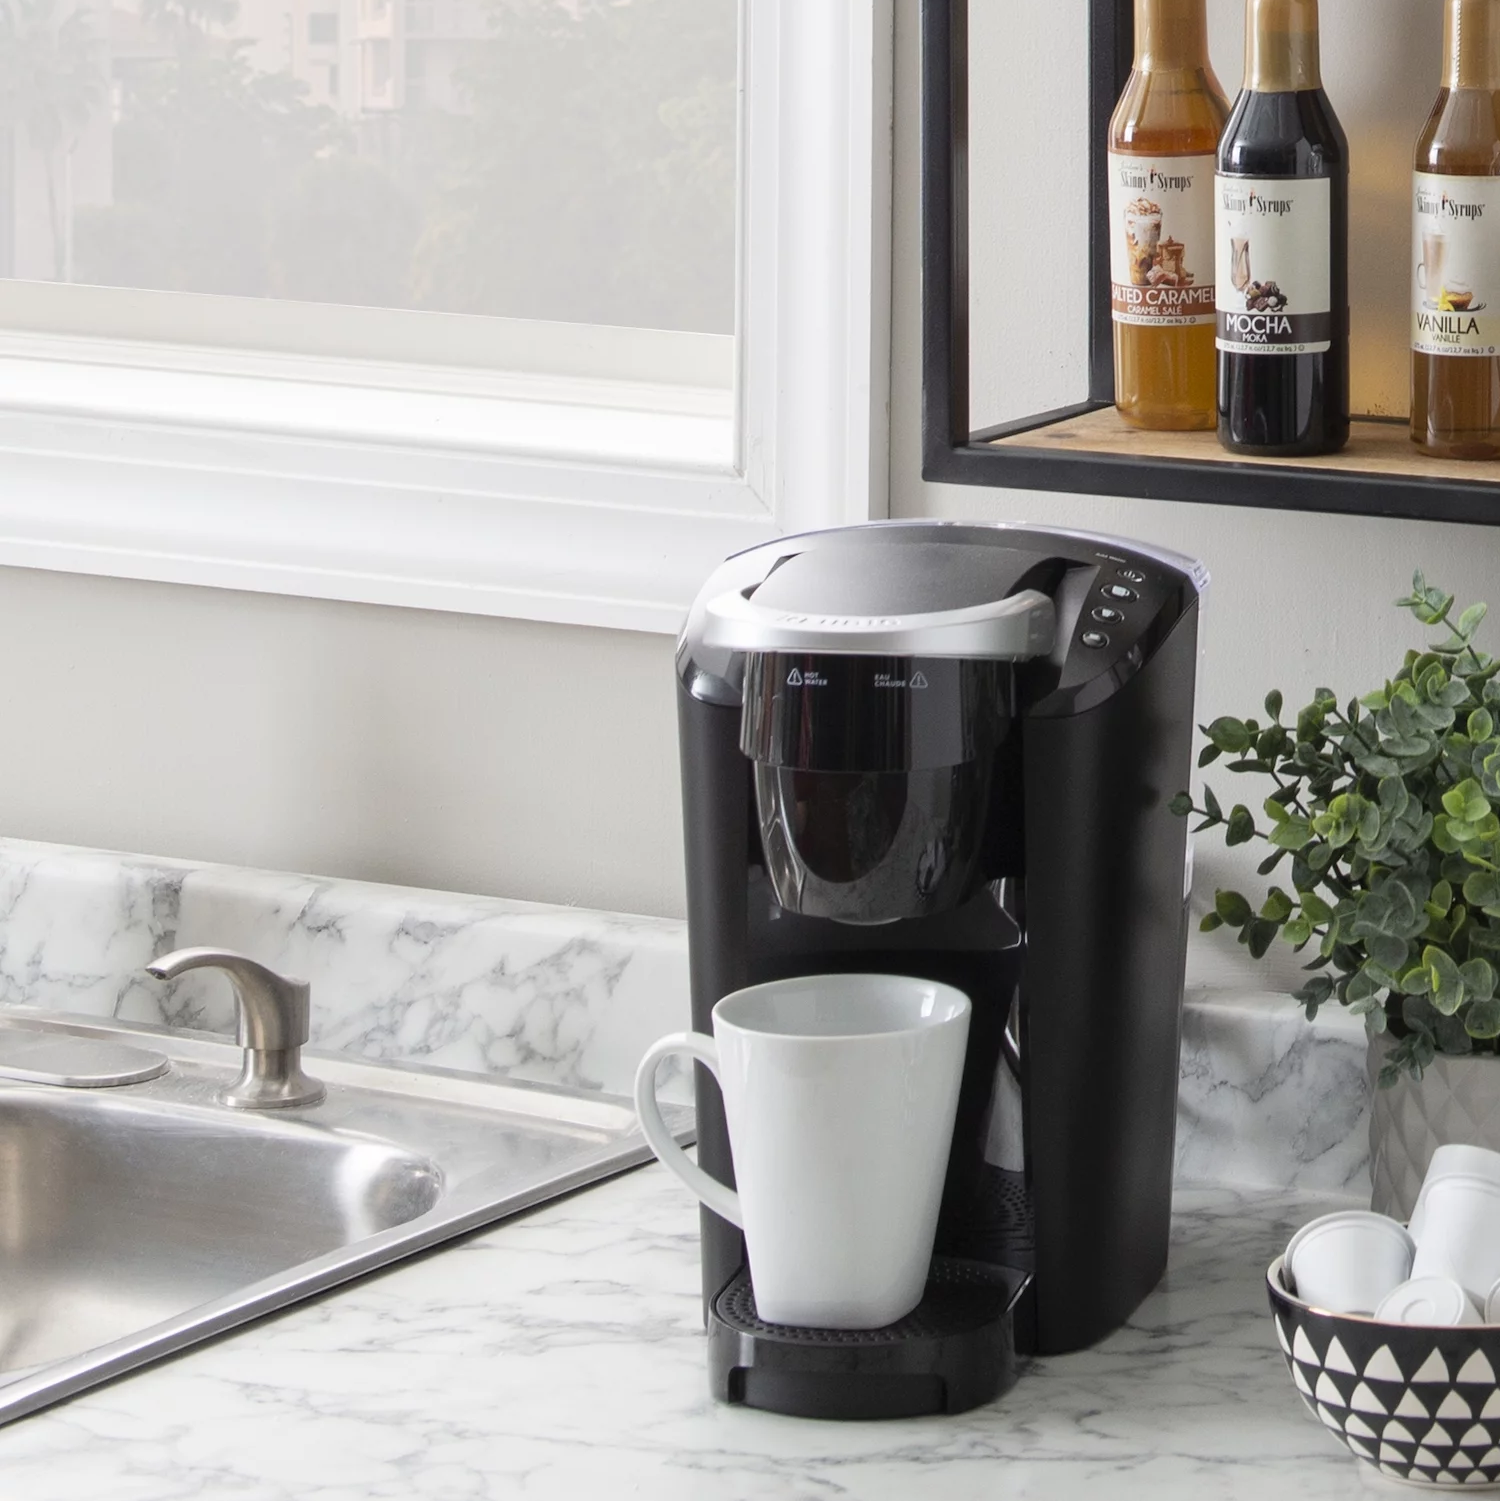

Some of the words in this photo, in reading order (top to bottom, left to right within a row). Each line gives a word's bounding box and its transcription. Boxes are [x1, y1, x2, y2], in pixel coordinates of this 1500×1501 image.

[1120, 171, 1147, 192] Skinny
[1157, 172, 1192, 192] Syrups
[1256, 196, 1291, 216] Syrups
[1449, 200, 1483, 220] Syrups
[1146, 288, 1215, 305] CARAMEL
[1127, 305, 1161, 315] CARAMEL
[1226, 313, 1292, 335] MOCHA
[1417, 312, 1480, 335] VANILLA
[1242, 333, 1268, 342] MOKA
[1432, 334, 1461, 344] VANILLE
[804, 671, 819, 679] HOT
[804, 678, 828, 686] WATER
[874, 680, 906, 688] CHAUDE
